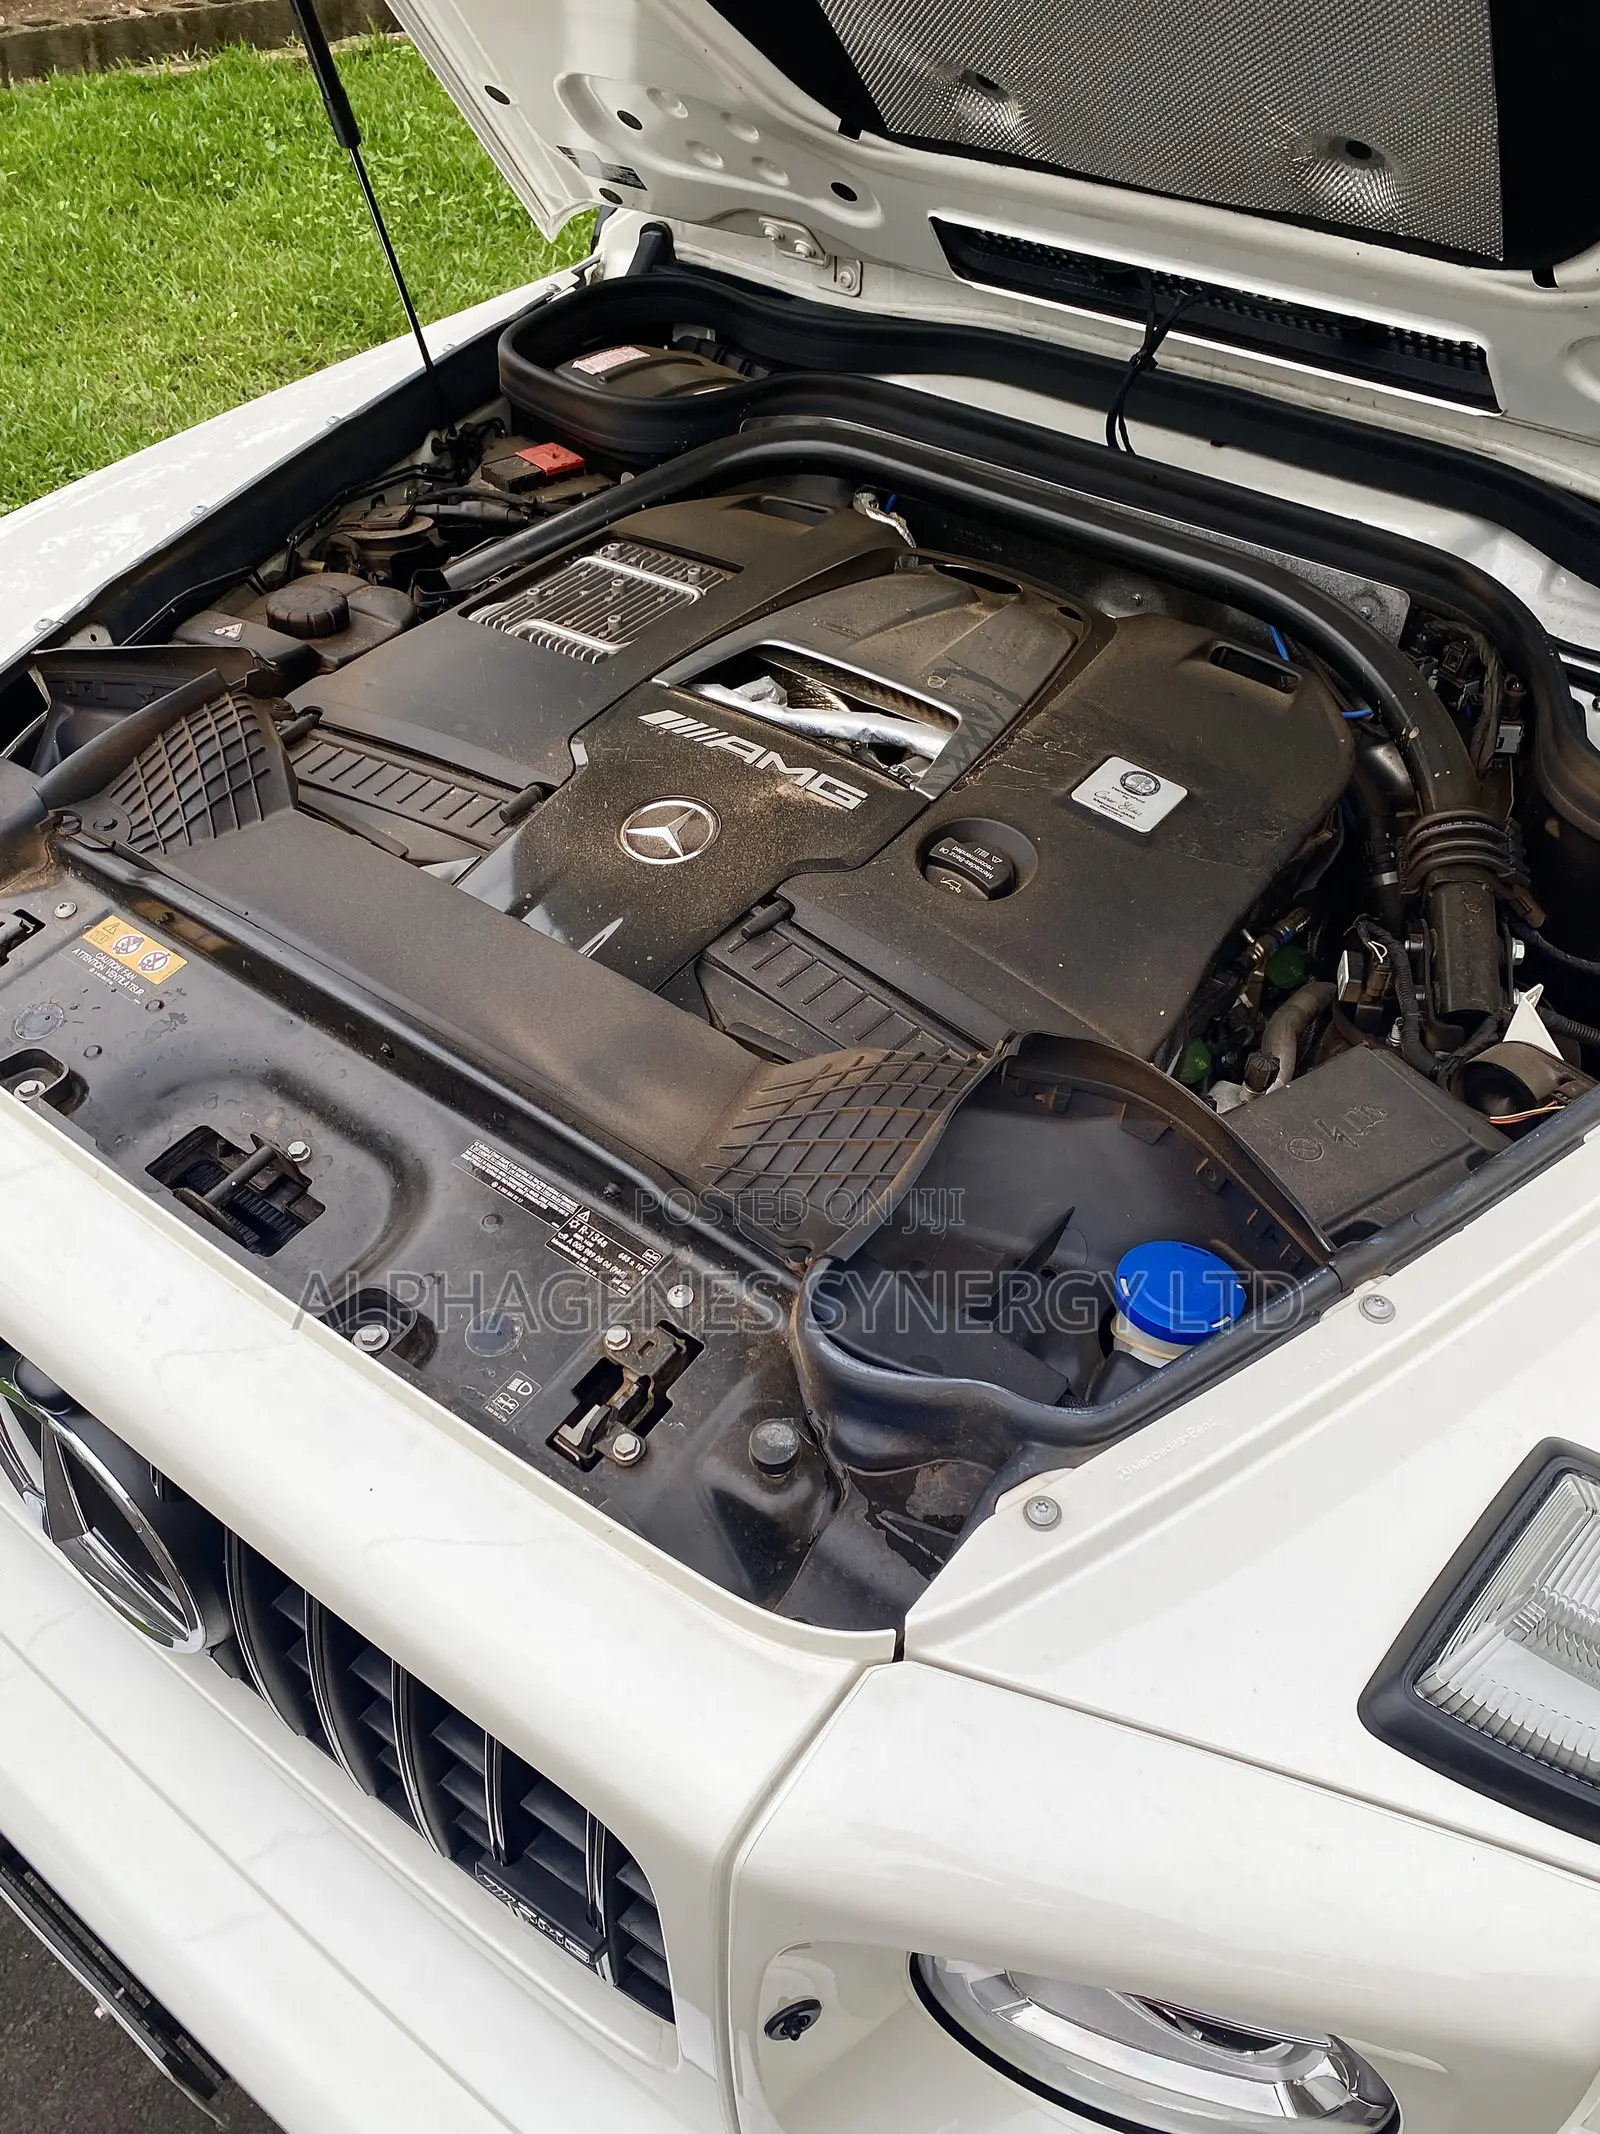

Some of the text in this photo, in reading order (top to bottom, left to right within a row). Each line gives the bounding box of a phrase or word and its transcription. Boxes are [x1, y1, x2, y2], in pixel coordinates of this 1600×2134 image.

[702, 734, 869, 811] AMG
[948, 851, 995, 880] Mercedes-Benz
[951, 845, 995, 871] recommended
[71, 948, 107, 972] ATTENTION
[104, 967, 145, 997] VENTILATEUR
[95, 952, 123, 974] CAUTION
[120, 968, 138, 981] FAN
[578, 1225, 609, 1248] R-134a
[572, 1241, 586, 1251] 000
[583, 1248, 597, 1258] 989
[602, 1260, 613, 1269] 06
[635, 1263, 645, 1271] 10
